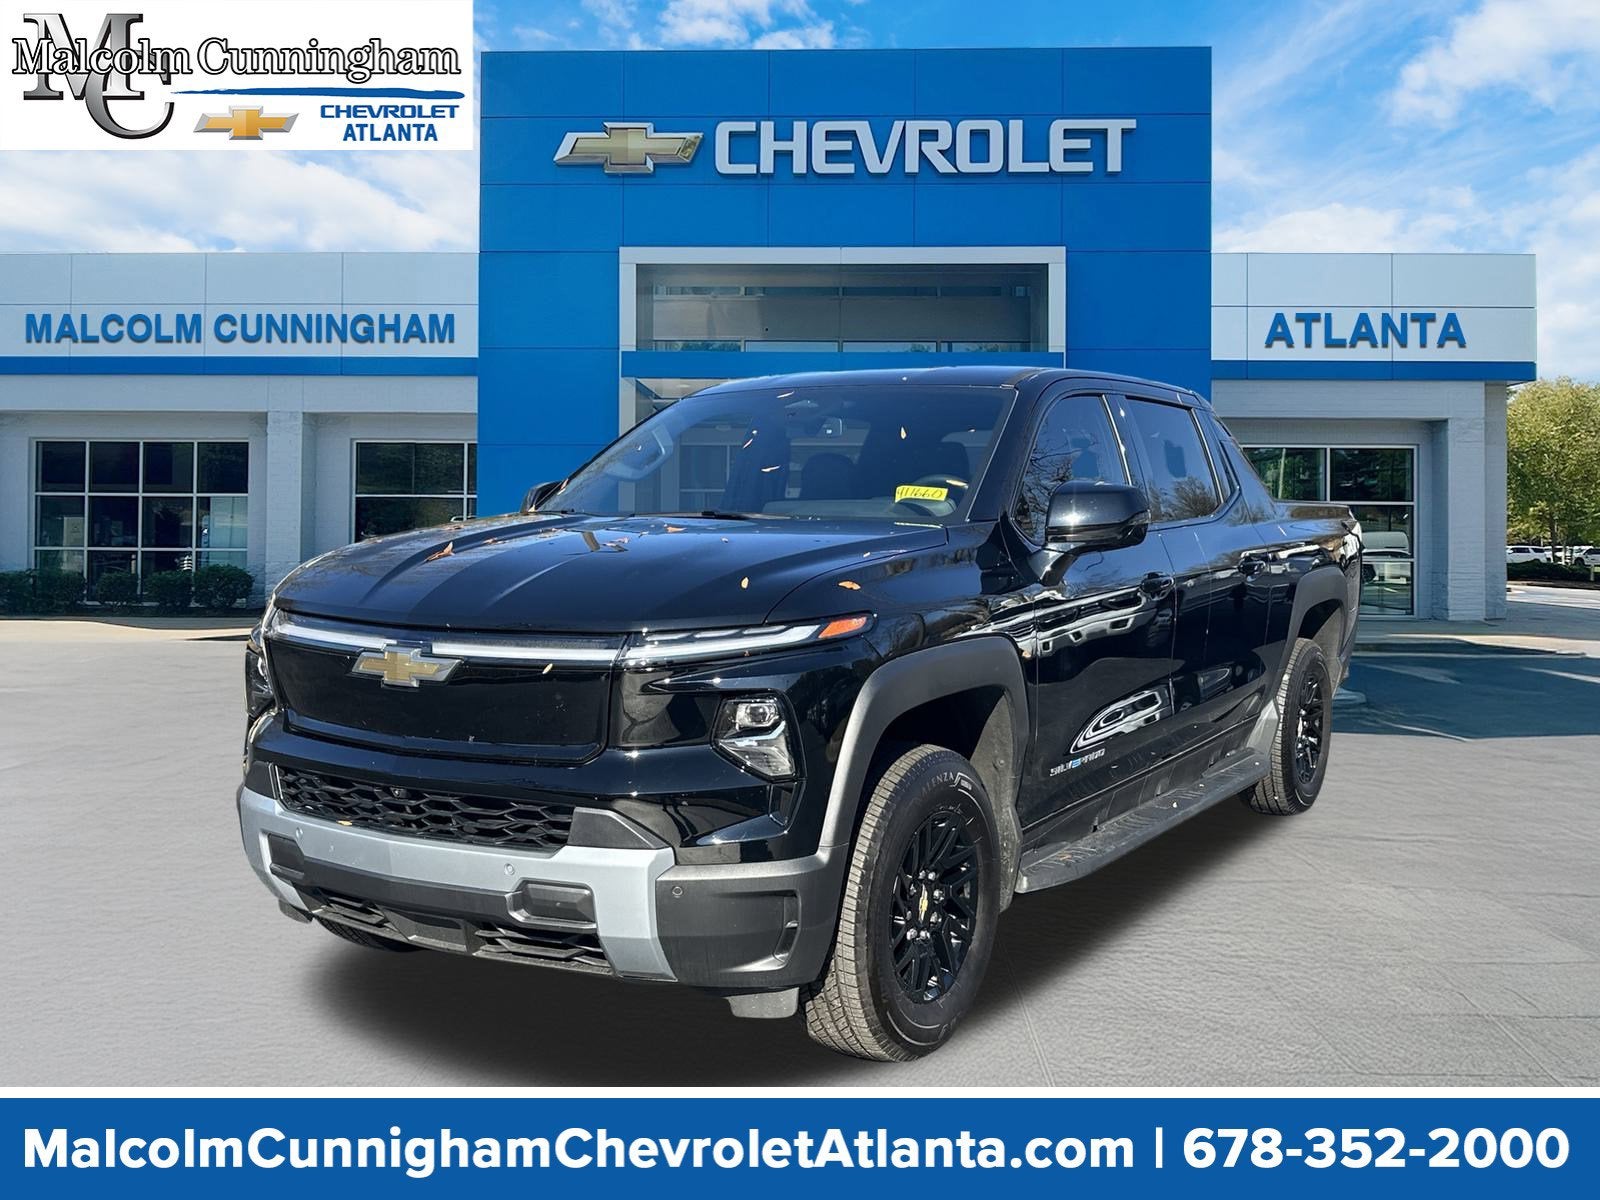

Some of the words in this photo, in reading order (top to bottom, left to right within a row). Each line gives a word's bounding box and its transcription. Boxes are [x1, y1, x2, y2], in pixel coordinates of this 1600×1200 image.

[714, 119, 1137, 175] CHEVROLET
[25, 313, 202, 343] MALCOLM
[214, 313, 456, 343] CUNNINGHAM
[1264, 312, 1467, 348] ATLANTA
